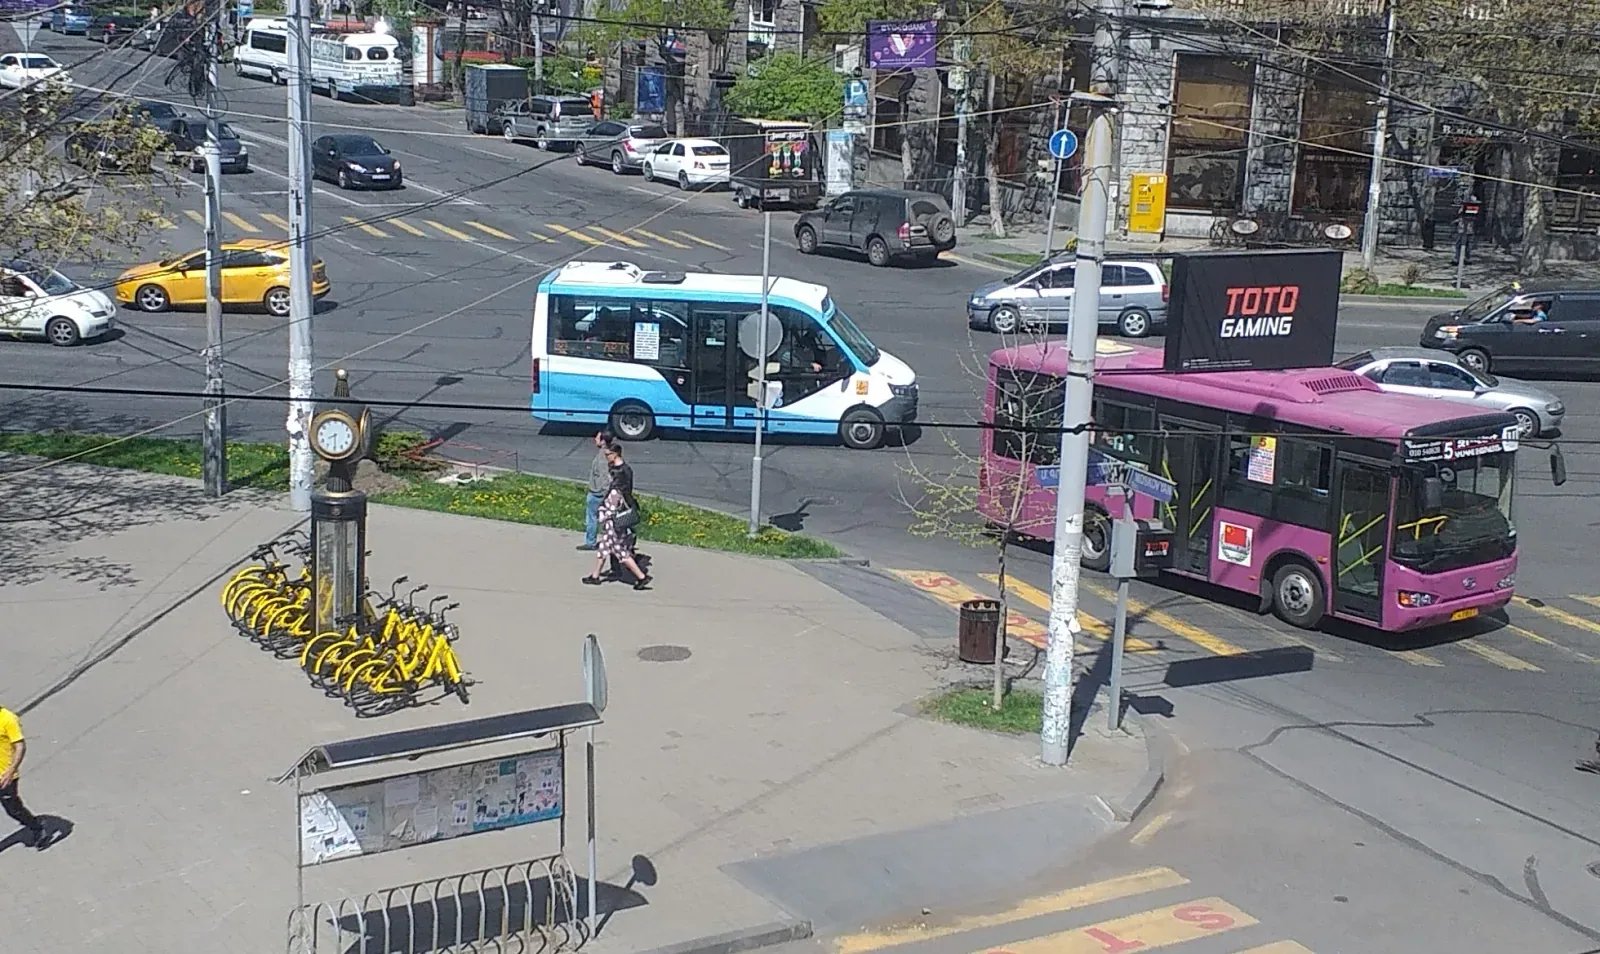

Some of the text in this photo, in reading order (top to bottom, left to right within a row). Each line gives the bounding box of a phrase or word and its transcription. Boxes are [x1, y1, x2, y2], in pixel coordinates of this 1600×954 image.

[1226, 286, 1299, 315] TOTO
[1220, 316, 1293, 338] GAMING
[1258, 437, 1267, 447] 5
[1443, 441, 1453, 460] 5
